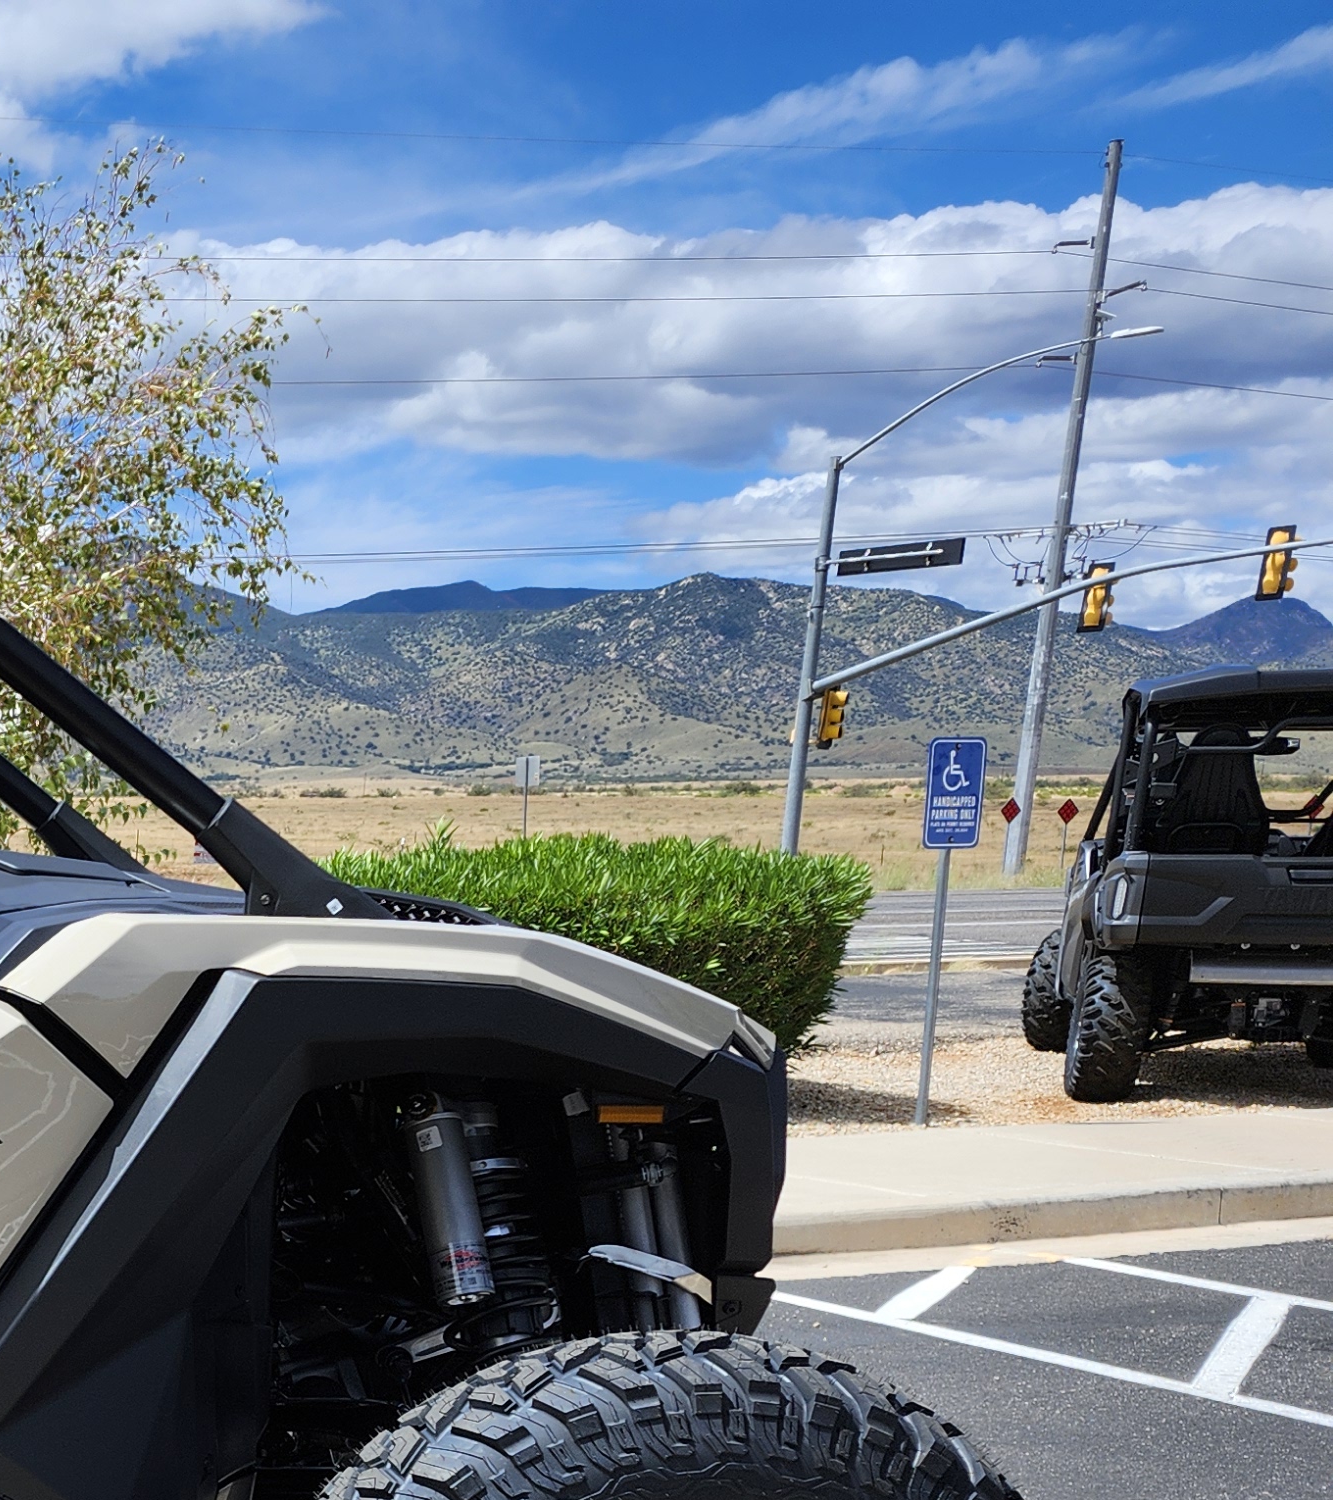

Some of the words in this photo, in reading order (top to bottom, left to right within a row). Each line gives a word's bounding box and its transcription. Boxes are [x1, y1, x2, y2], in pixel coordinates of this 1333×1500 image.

[933, 795, 976, 807] HANDICAPPED
[931, 809, 958, 820] PARKING
[960, 809, 976, 820] ONLY
